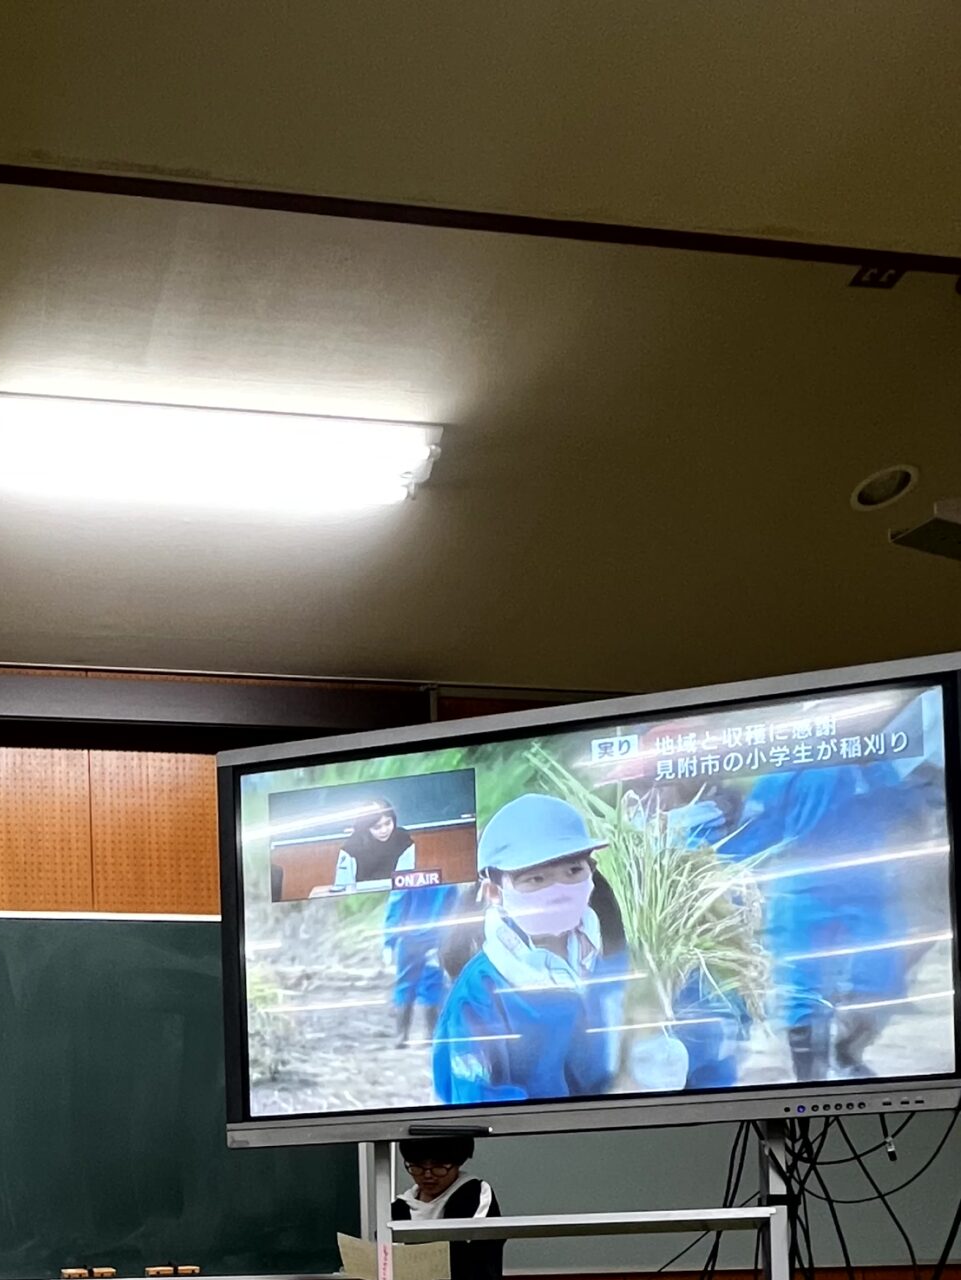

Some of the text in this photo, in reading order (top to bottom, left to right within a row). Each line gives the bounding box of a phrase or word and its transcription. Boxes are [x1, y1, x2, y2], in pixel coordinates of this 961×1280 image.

[597, 740, 631, 758] 実り
[654, 732, 909, 781] 見附市の小学生が稲刈り
[395, 872, 439, 887] ON AIR
